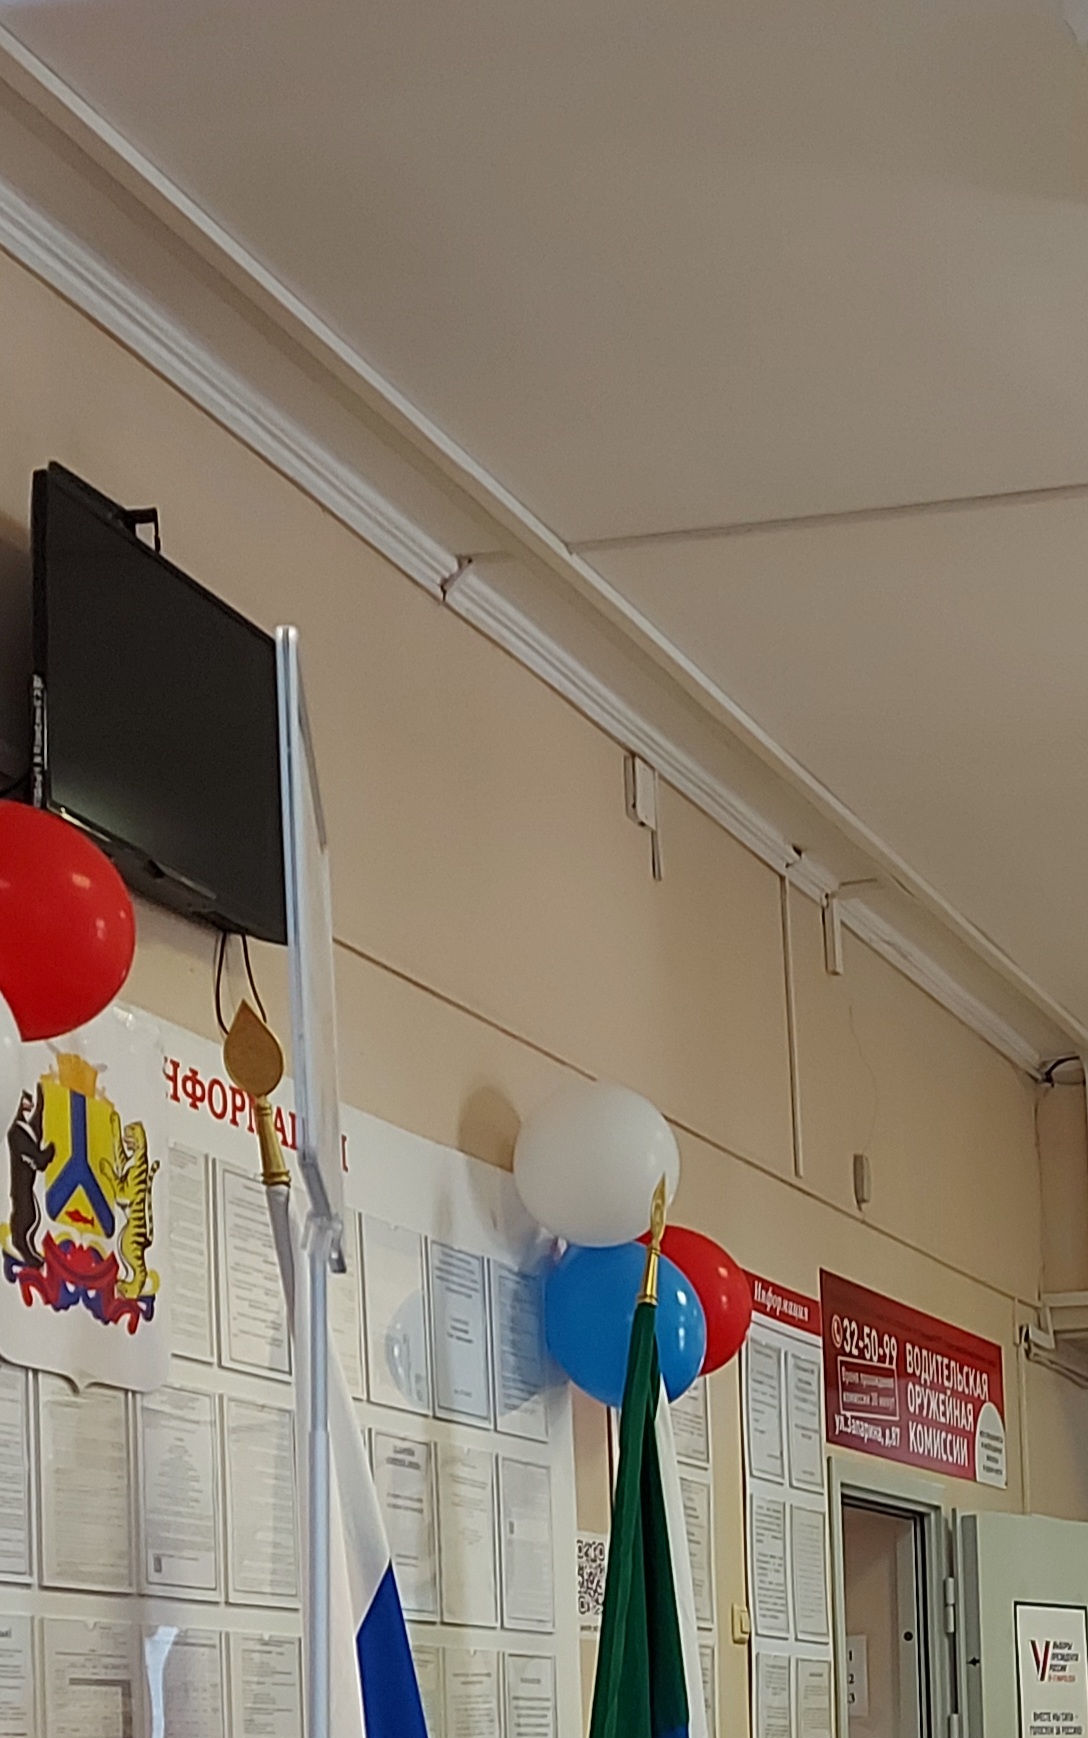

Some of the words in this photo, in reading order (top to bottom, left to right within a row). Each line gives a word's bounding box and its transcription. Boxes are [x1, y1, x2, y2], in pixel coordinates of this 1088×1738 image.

[843, 1318, 897, 1367] 32-50-99
[906, 1343, 989, 1401] ВОДИТЕЛЬСКАЯ
[907, 1382, 974, 1432] ОРУЖЕЙНАЯ
[909, 1421, 968, 1467] КОМИССИИ
